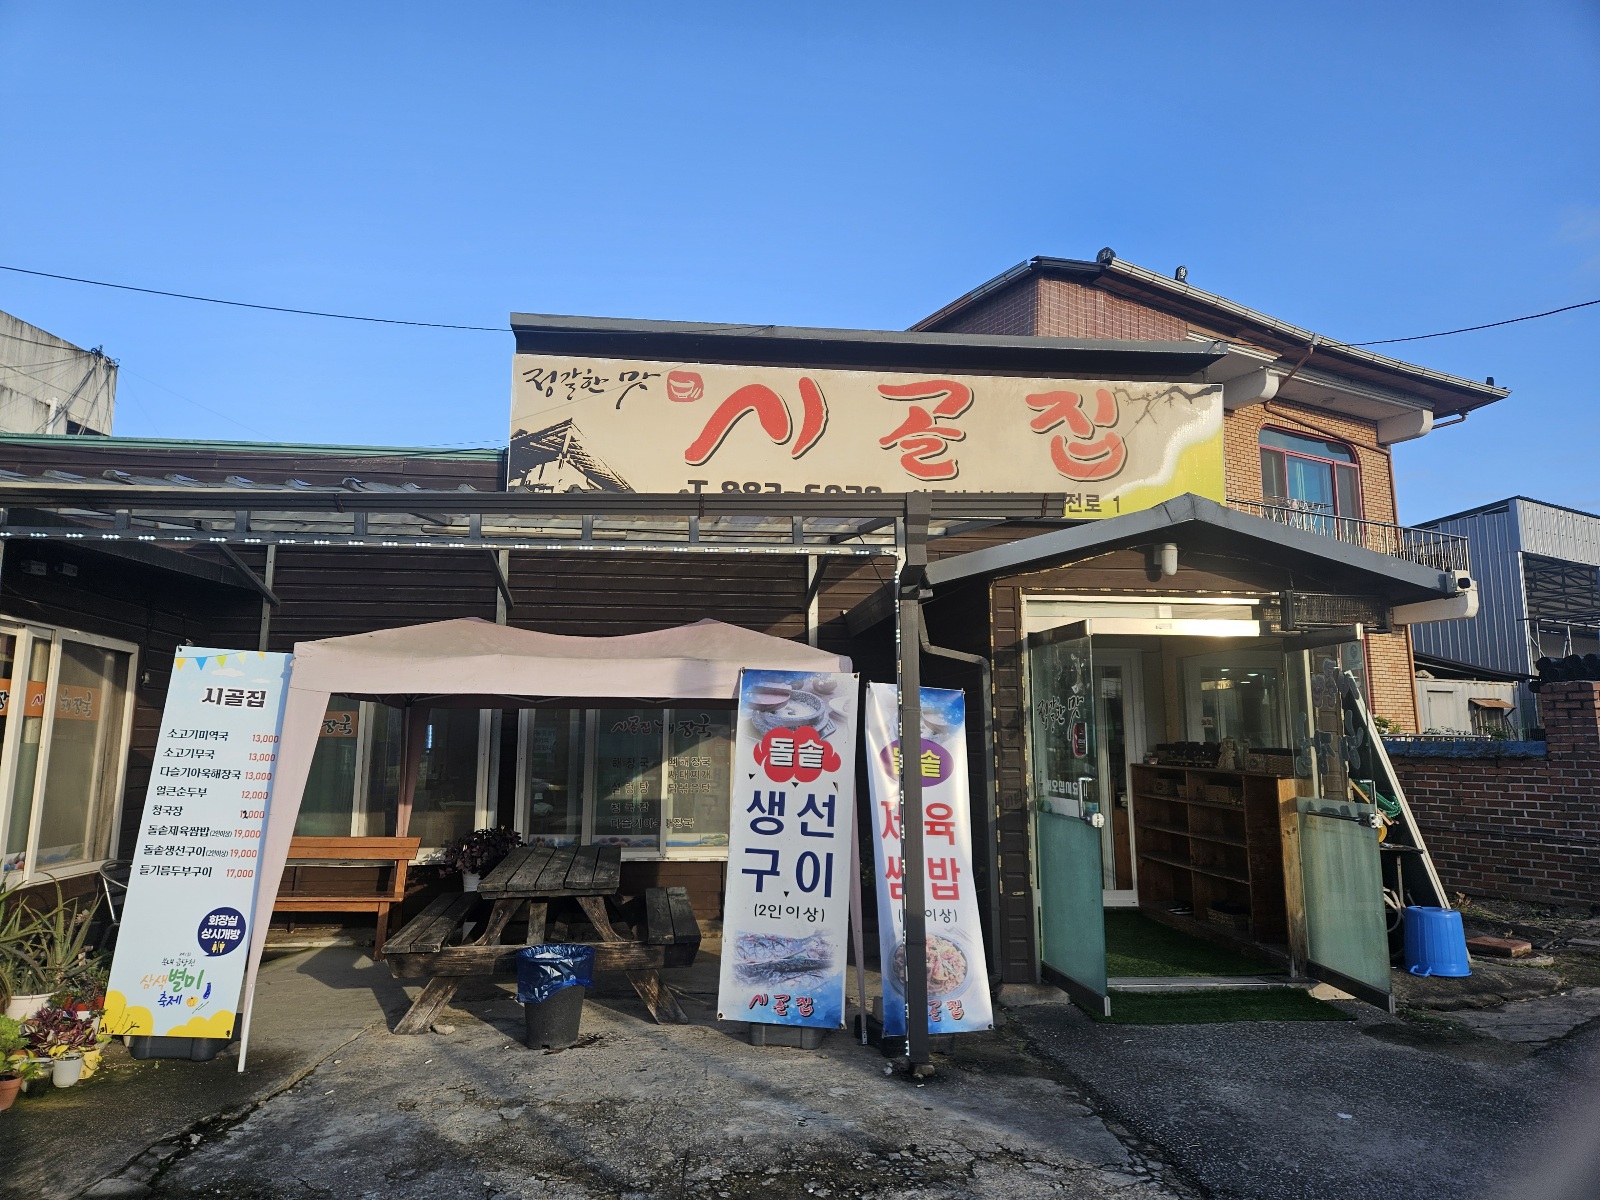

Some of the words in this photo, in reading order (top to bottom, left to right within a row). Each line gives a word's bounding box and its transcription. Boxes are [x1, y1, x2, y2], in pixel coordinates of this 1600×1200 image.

[522, 367, 609, 401] 정갈한
[615, 370, 661, 410] 맛
[684, 376, 1127, 482] 시골집
[201, 687, 266, 708] 시골집
[321, 713, 353, 735] 장국
[167, 729, 229, 741] 소고기미역국
[252, 734, 279, 743] 13,000
[163, 748, 215, 760] 소고기무국
[248, 753, 276, 762] 13,000
[769, 737, 825, 769] 돌솥
[159, 767, 241, 780] 다슬기아욱해장국
[245, 771, 272, 781] 13,000
[156, 785, 208, 798] 얼큰순두부
[241, 791, 269, 800] 12,000
[152, 805, 183, 817] 청국장
[746, 790, 836, 839] 생선
[148, 825, 210, 837] 돌솥제육쌈밥
[233, 829, 261, 839] 19,000
[143, 845, 206, 857] 돌솥생선구이
[230, 849, 258, 858] 19,000
[139, 865, 213, 878] 들기름두부구이
[226, 868, 254, 878] 17,000
[741, 848, 835, 898] 구이
[207, 914, 239, 927] 화장실
[754, 904, 825, 923] (2인이상)
[201, 928, 241, 940] 상시개방
[140, 973, 169, 990] 삼색
[168, 967, 205, 993] 별미
[157, 990, 183, 1008] 축제
[749, 993, 815, 1018] 시골집
